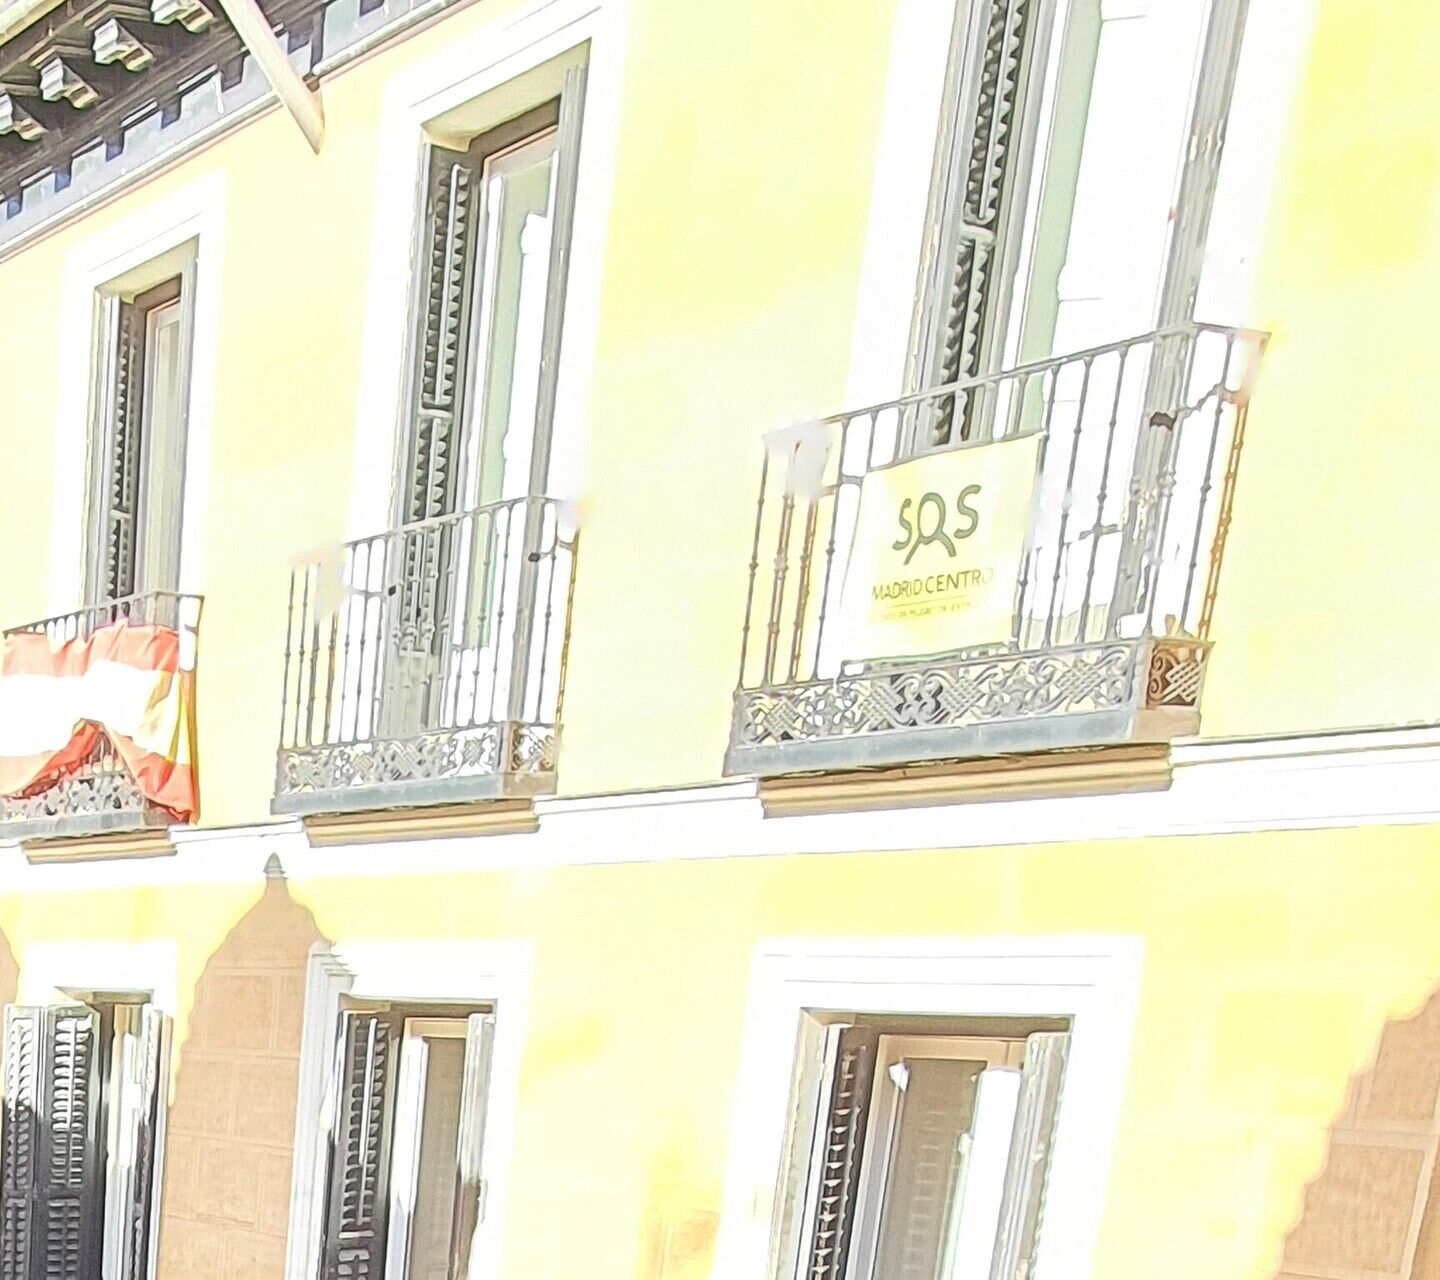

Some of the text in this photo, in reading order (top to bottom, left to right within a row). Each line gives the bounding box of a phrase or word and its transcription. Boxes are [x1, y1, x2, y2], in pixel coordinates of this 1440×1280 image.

[891, 483, 983, 564] SOS
[871, 567, 994, 601] MADRID CENTRO
